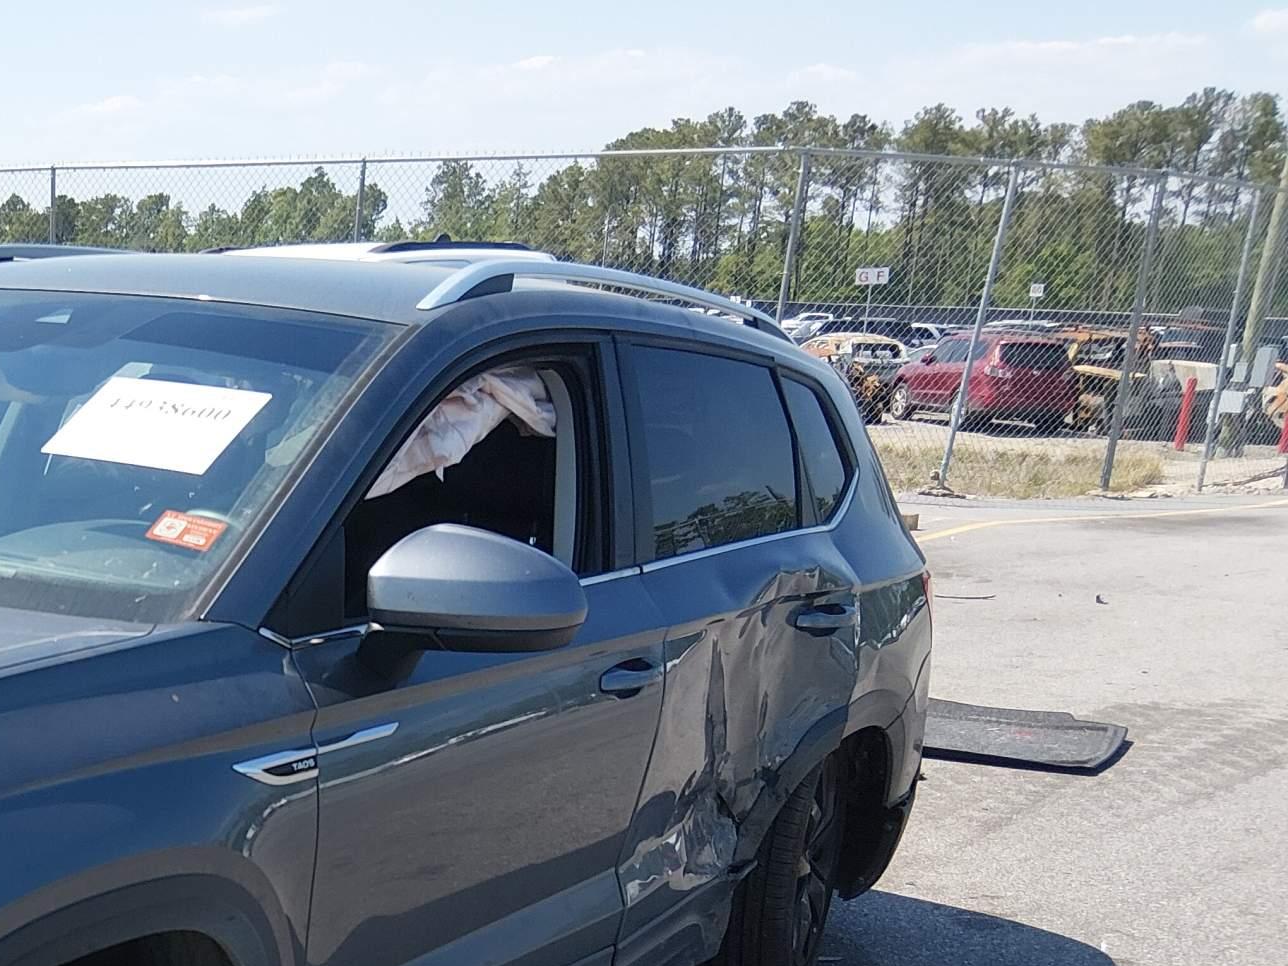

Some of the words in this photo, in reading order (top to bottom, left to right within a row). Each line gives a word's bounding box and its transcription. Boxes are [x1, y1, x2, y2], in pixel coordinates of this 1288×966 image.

[858, 271, 869, 283] G
[876, 270, 885, 281] F
[292, 758, 315, 771] TAOS
